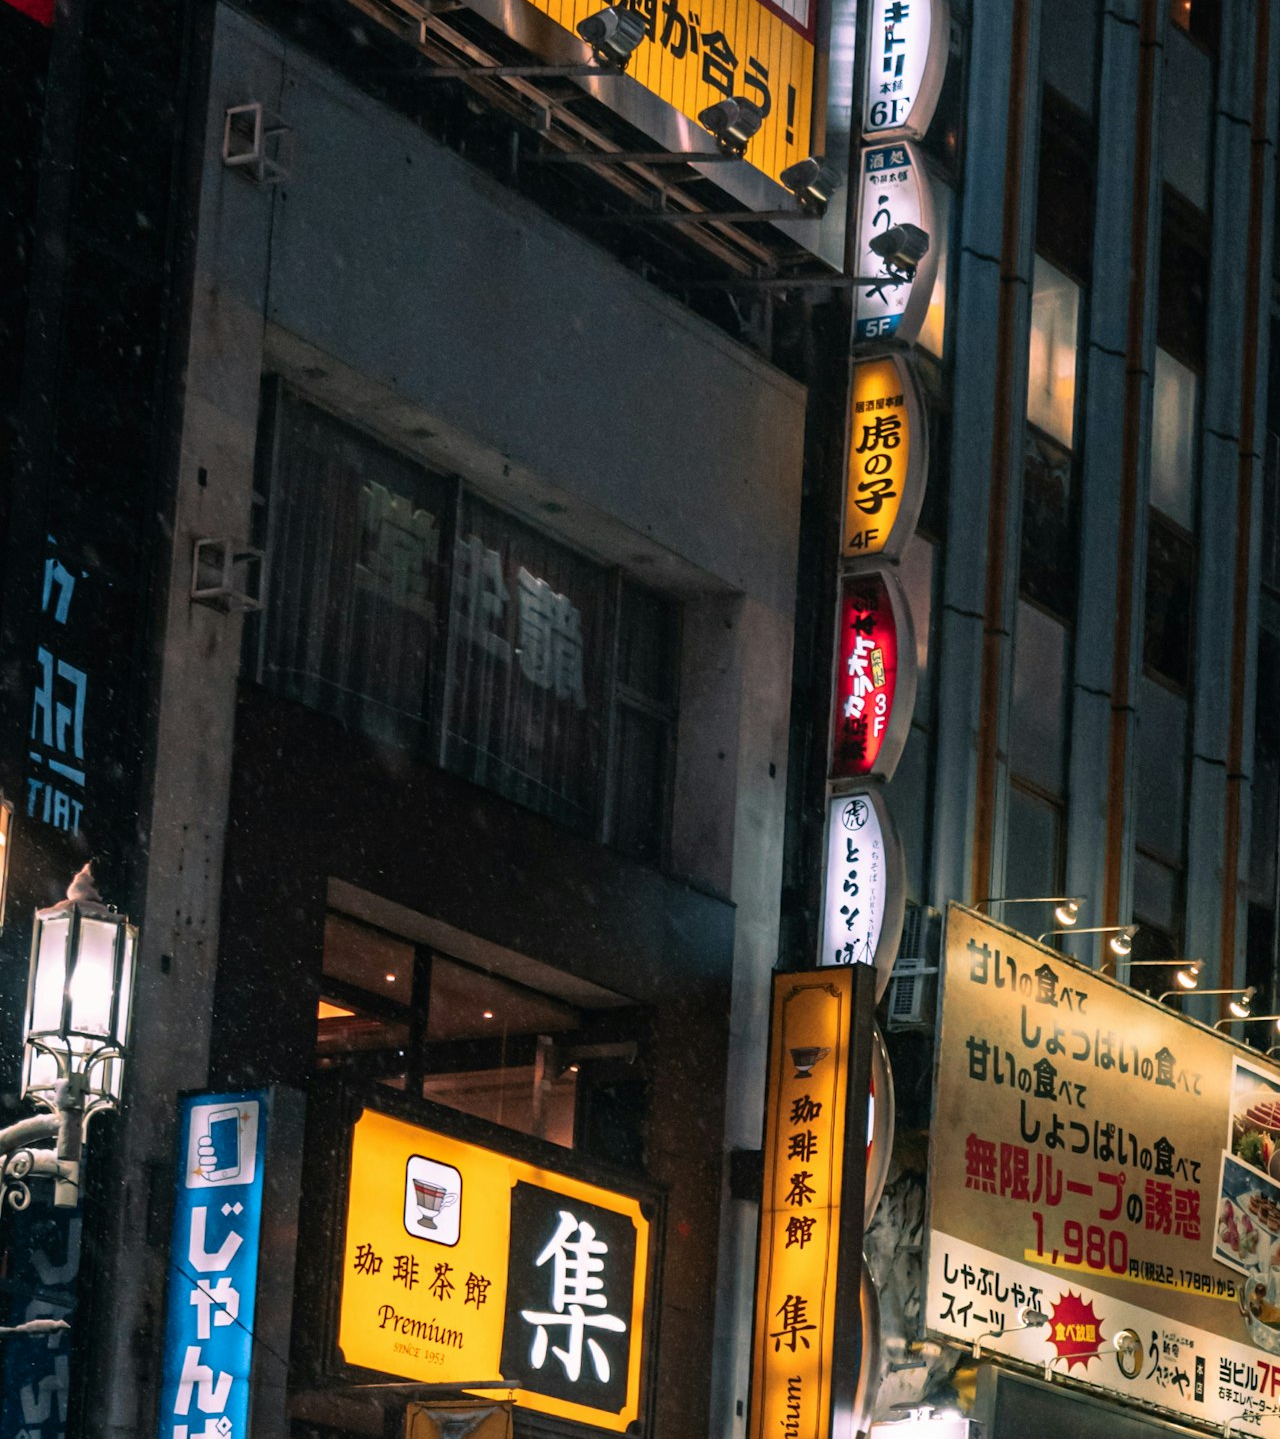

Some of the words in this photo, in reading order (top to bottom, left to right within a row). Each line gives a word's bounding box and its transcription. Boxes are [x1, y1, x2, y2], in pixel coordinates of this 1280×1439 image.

[869, 97, 910, 128] 6F
[865, 319, 890, 337] 5F
[855, 415, 902, 515] 虎の子
[849, 528, 878, 550] 4F
[966, 938, 1089, 1017] 甘いの食べて
[966, 1035, 1088, 1109] 甘いの食べて
[1020, 1007, 1202, 1097] しょっぱいの食べて
[784, 1096, 822, 1251] 珈琲茶館
[1018, 1098, 1201, 1185] しょっぱいの食べて
[965, 1133, 1201, 1241] 無限ループの誘惑
[353, 1241, 493, 1312] 珈琲茶館
[520, 1210, 627, 1383] 集
[939, 1291, 1005, 1331] スイーツ
[943, 1253, 1043, 1314] しゃぶしゃぶ
[377, 1303, 464, 1351] Premium
[770, 1294, 817, 1352] 集
[1055, 1322, 1097, 1344] 食べ放題
